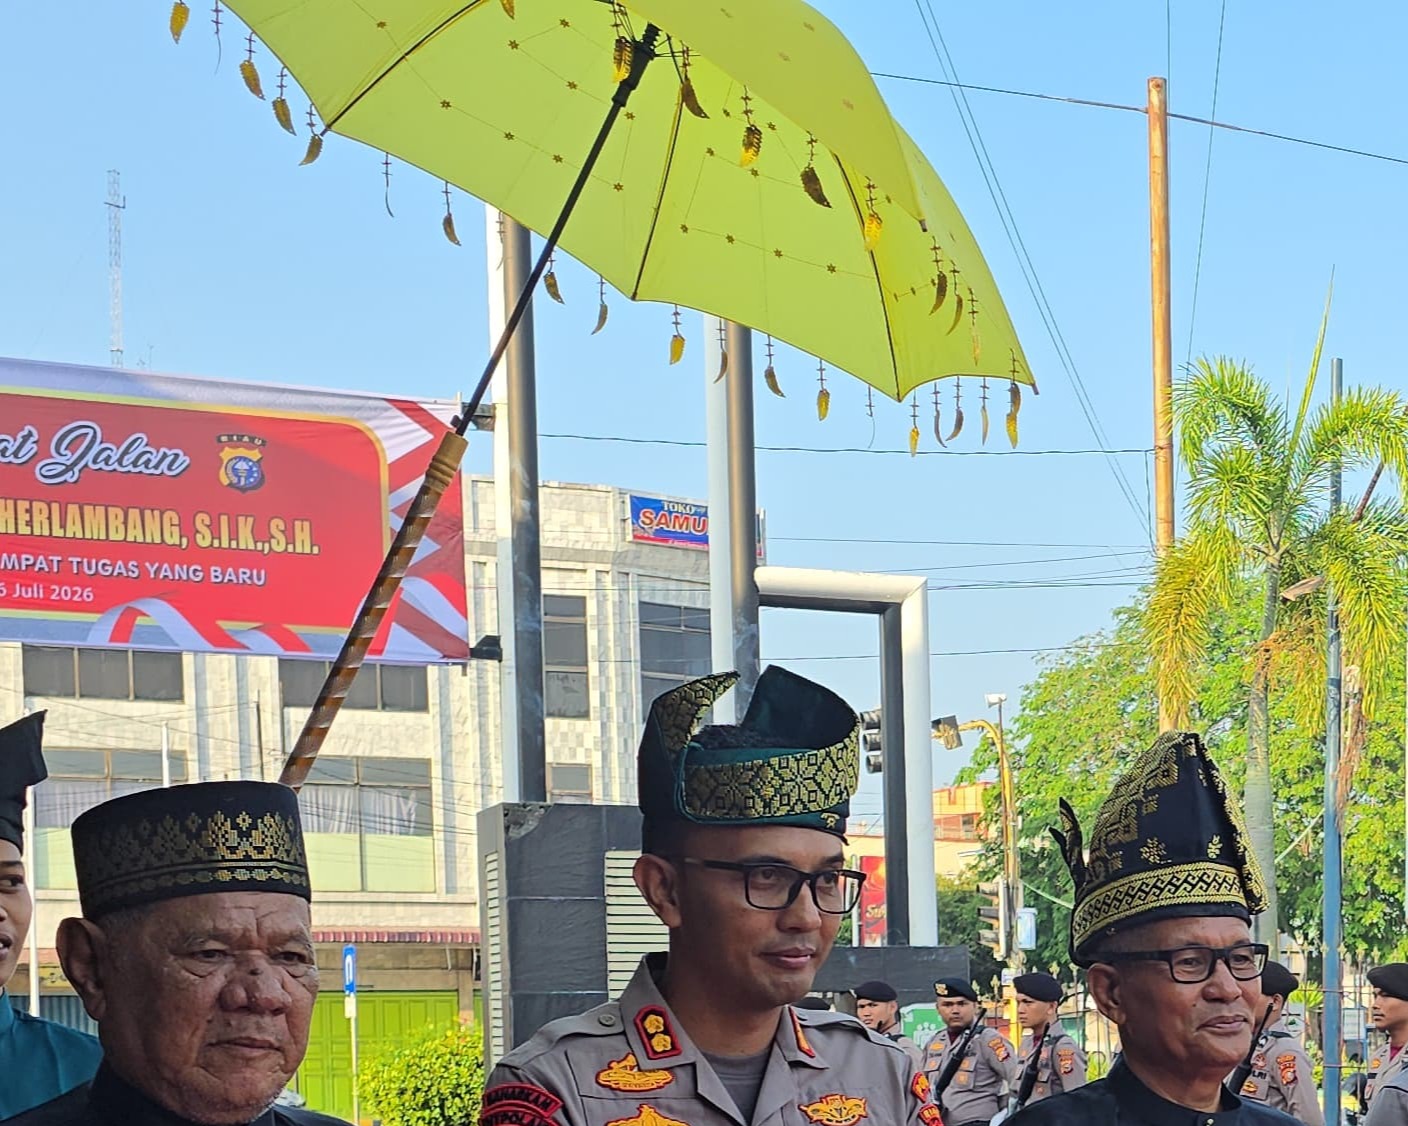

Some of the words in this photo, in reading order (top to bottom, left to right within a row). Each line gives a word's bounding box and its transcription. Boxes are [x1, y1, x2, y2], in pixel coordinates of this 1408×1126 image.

[35, 421, 190, 484] Jalan
[661, 501, 695, 514] TOKO
[640, 509, 708, 535] SAMU
[68, 557, 140, 578] TUGAS
[145, 562, 204, 582] YANG
[210, 566, 266, 586] BARU
[12, 583, 44, 598] Juli
[50, 585, 94, 601] 2026
